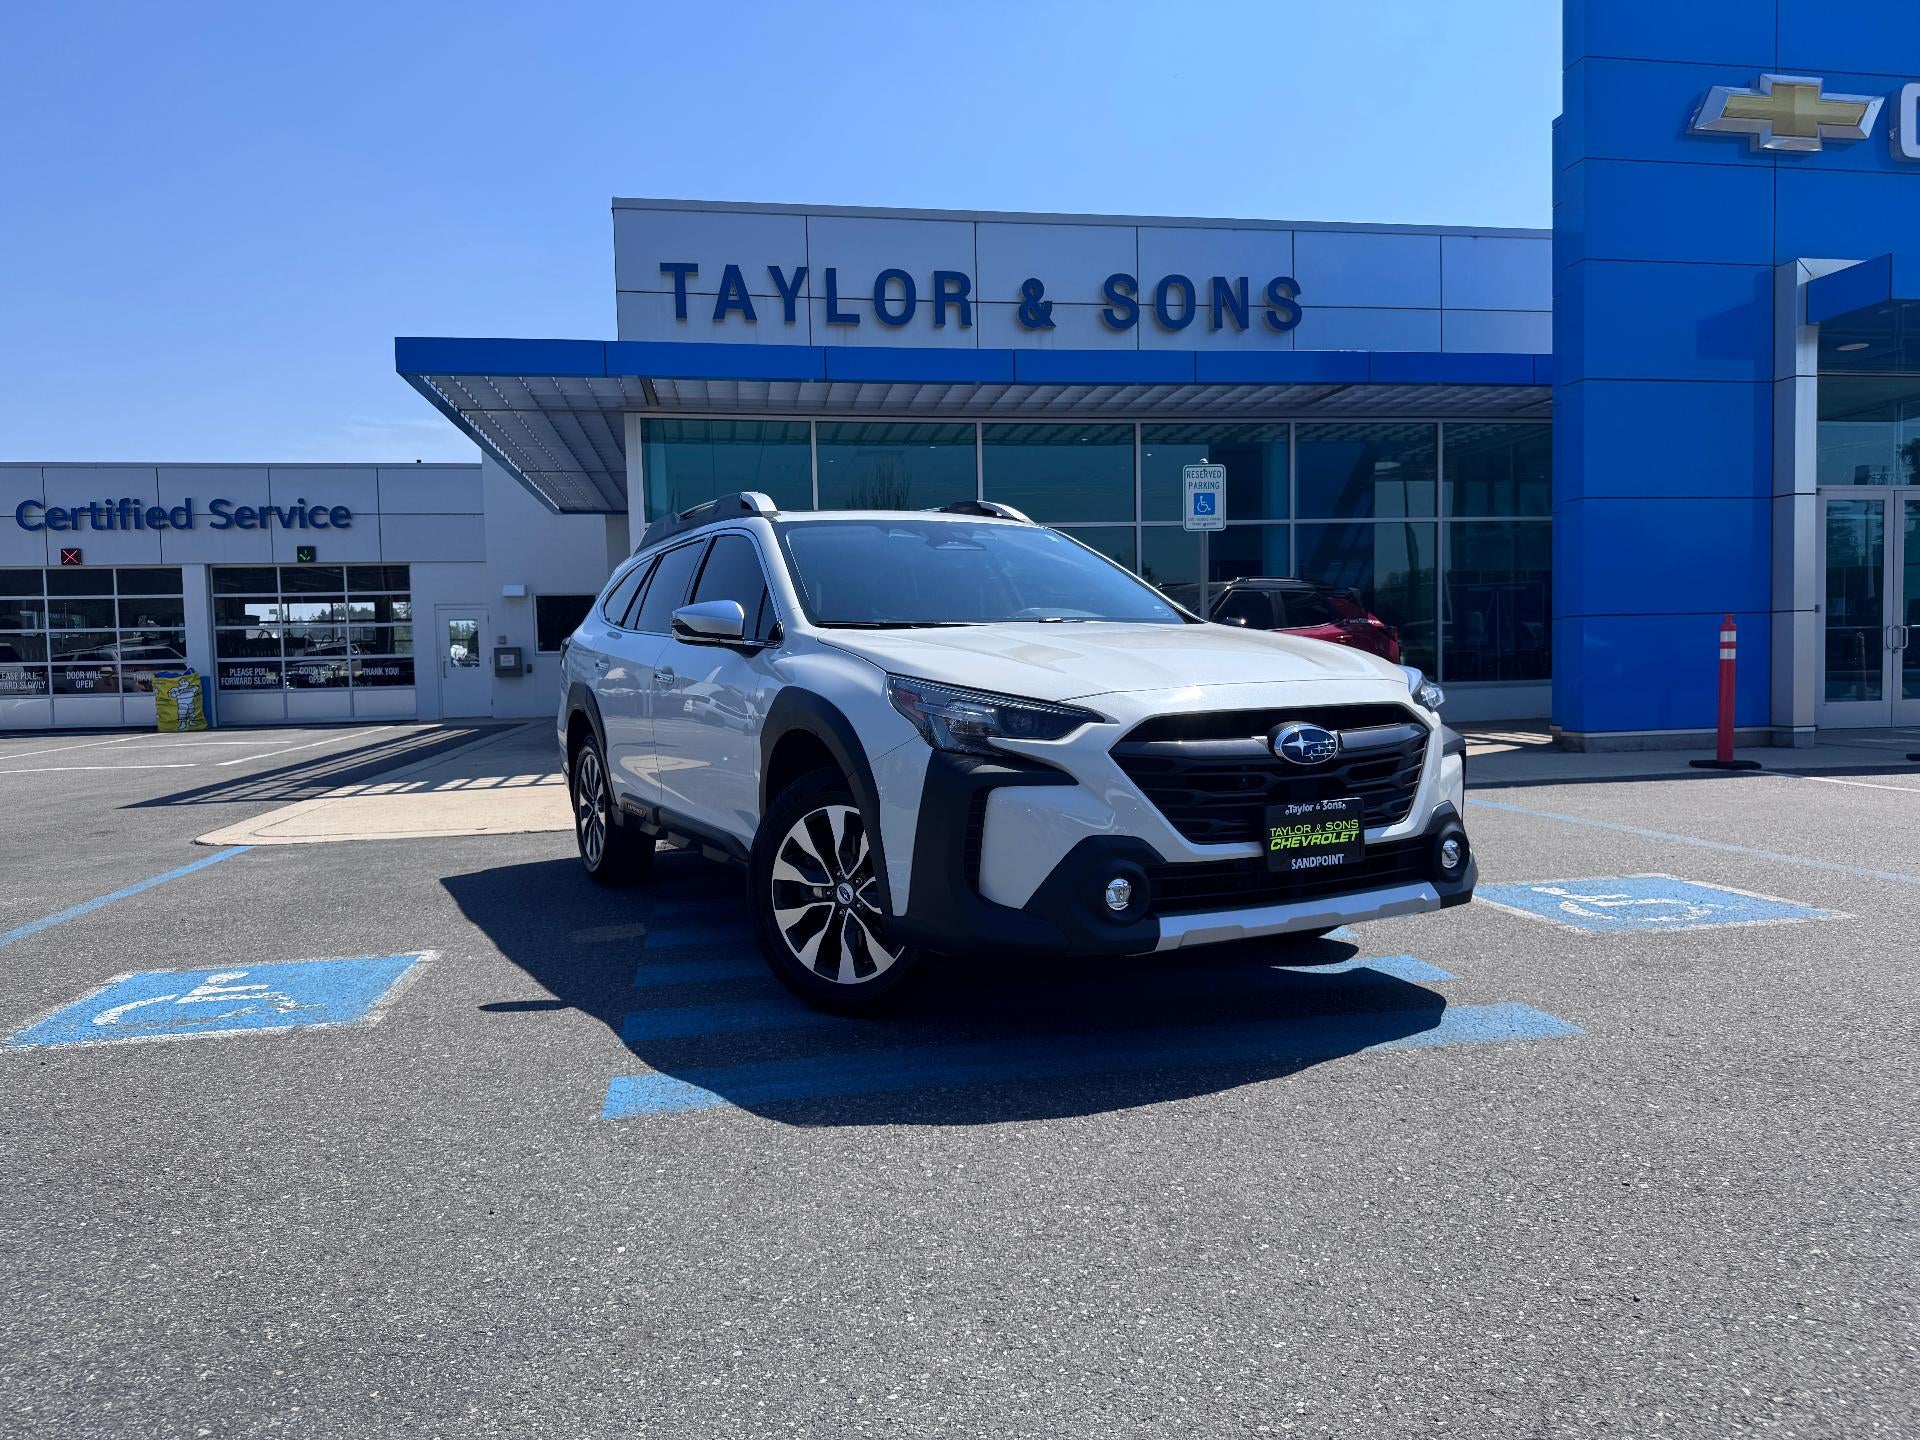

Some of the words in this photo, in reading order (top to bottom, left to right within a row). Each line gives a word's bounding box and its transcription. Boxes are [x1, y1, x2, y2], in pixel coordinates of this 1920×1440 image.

[659, 262, 973, 328] TAYLOR
[1017, 277, 1056, 329] &
[1101, 273, 1302, 332] SONS
[1186, 470, 1222, 479] RESERVED
[1188, 481, 1220, 490] PARKING
[15, 497, 195, 531] Certified
[208, 498, 353, 530] Service
[66, 670, 85, 680] DOOR
[86, 670, 103, 679] WILL
[229, 667, 254, 677] PLEASE
[254, 667, 269, 676] PULL
[362, 667, 384, 677] THANK
[384, 666, 400, 676] YOU!
[133, 672, 151, 682] THAN
[220, 677, 253, 686] FORWARD
[253, 676, 280, 685] SLOWLY
[19, 680, 46, 689] SLOWLY
[75, 679, 94, 689] OPEN
[1288, 803, 1314, 816] Taylor
[1322, 801, 1342, 811] Sons
[1269, 824, 1312, 838] TAYLOR
[1314, 824, 1322, 834] &
[1325, 819, 1359, 831] SONS
[1270, 830, 1360, 851] CHEVROLET
[1291, 854, 1344, 869] SANDPOINT
